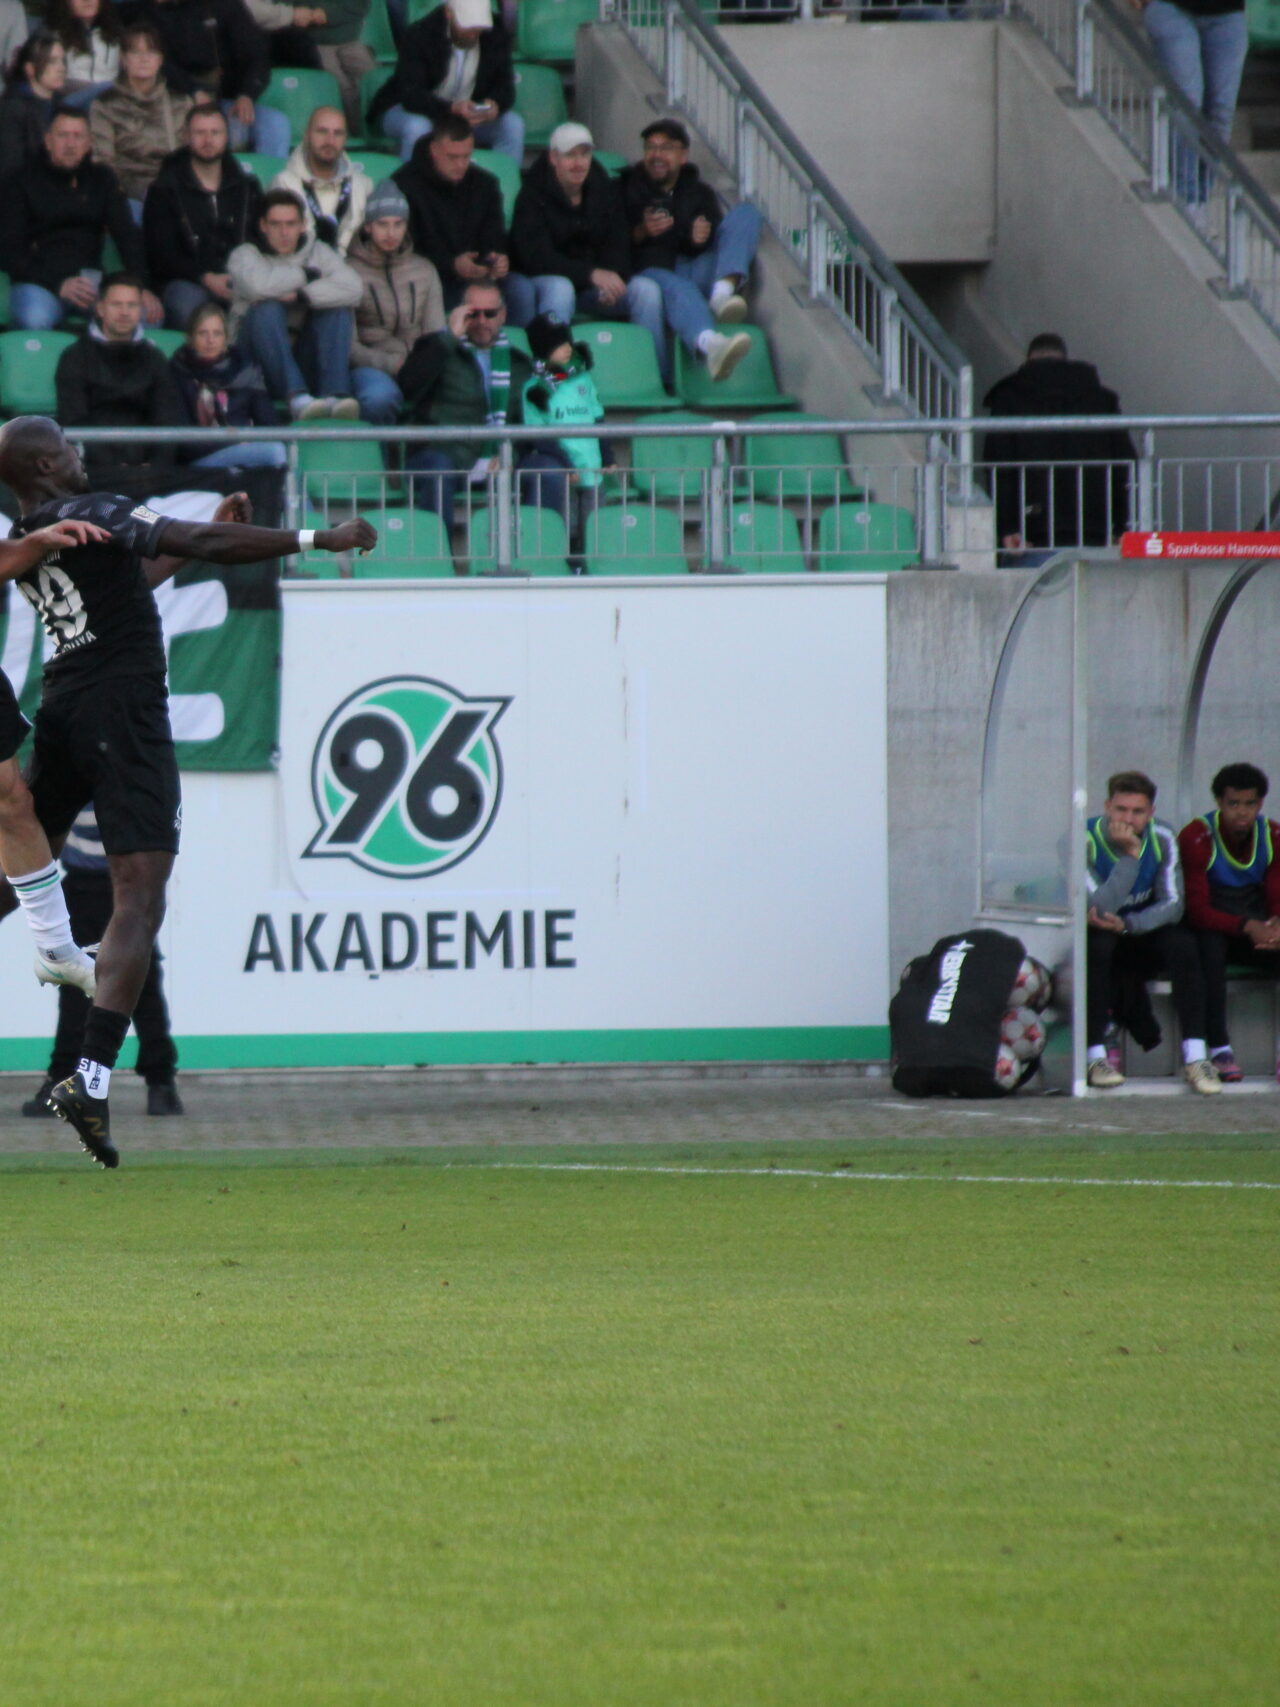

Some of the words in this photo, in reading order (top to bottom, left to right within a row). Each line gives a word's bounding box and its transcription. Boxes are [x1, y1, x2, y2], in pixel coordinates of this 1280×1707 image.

[1169, 542, 1225, 559] Sparkasse
[1227, 542, 1280, 556] Hannove
[243, 908, 577, 974] AKADEMIE
